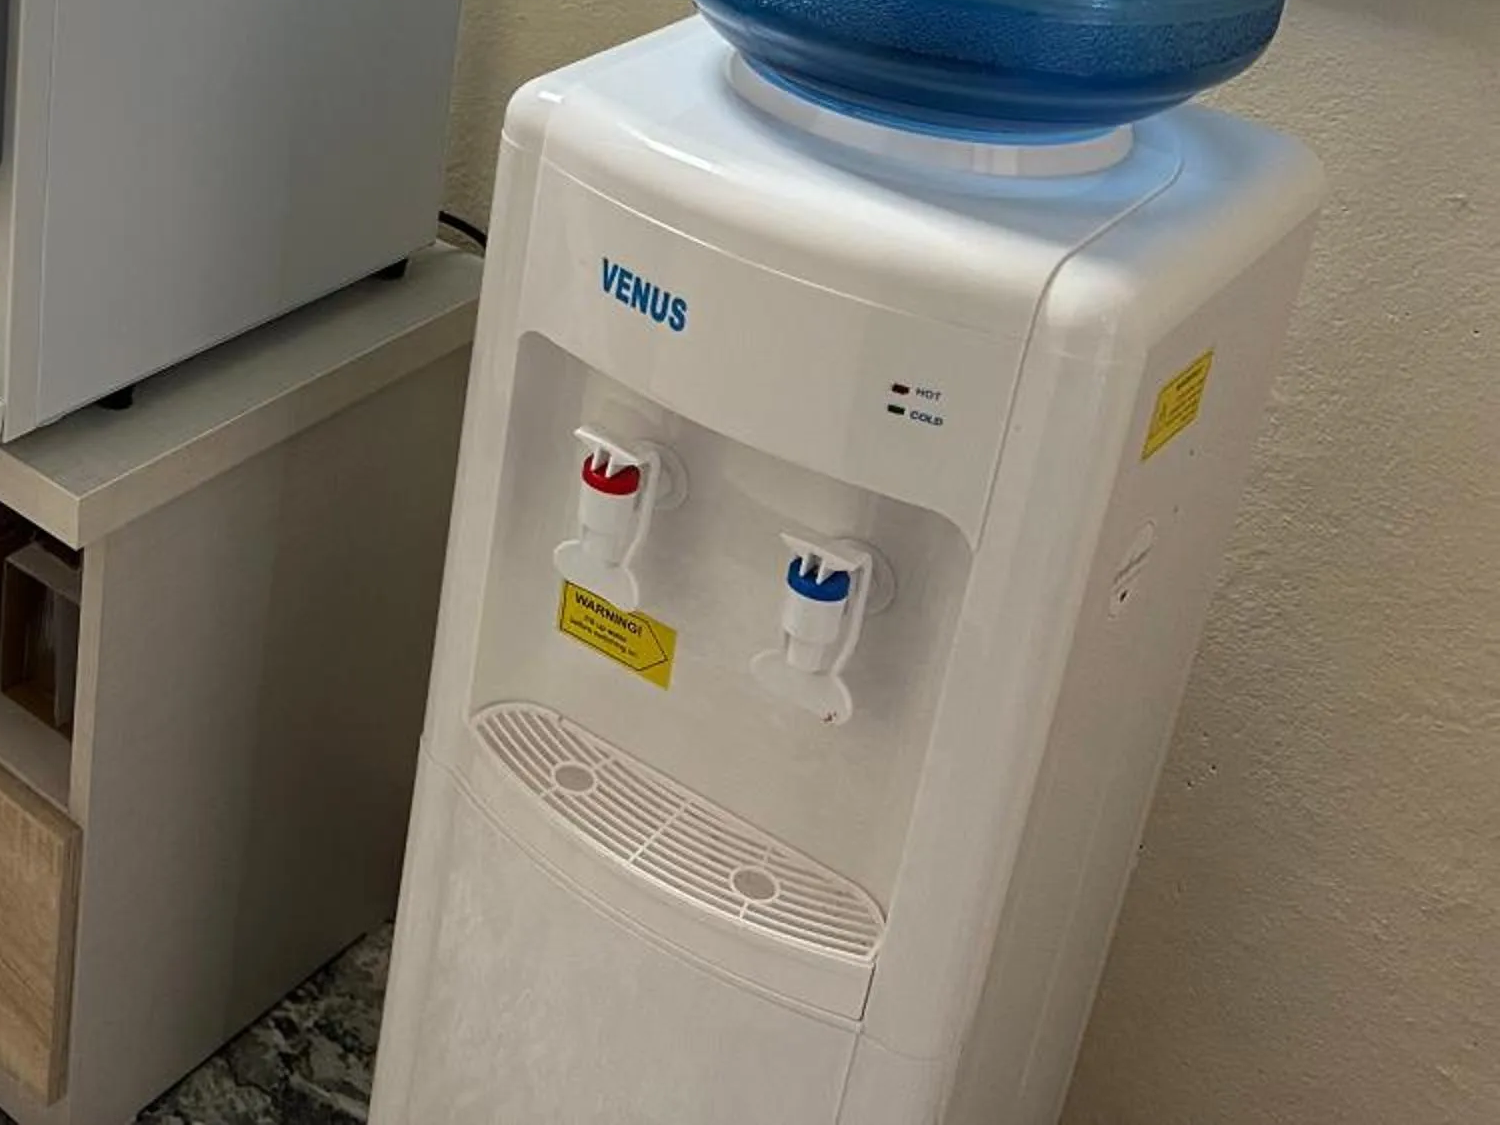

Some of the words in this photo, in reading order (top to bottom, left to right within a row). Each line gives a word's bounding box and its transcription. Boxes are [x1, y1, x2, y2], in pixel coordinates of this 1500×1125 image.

[603, 257, 687, 332] VENUS
[915, 386, 943, 402] HOT
[909, 409, 944, 427] COLD
[574, 590, 644, 639] WARNING!
